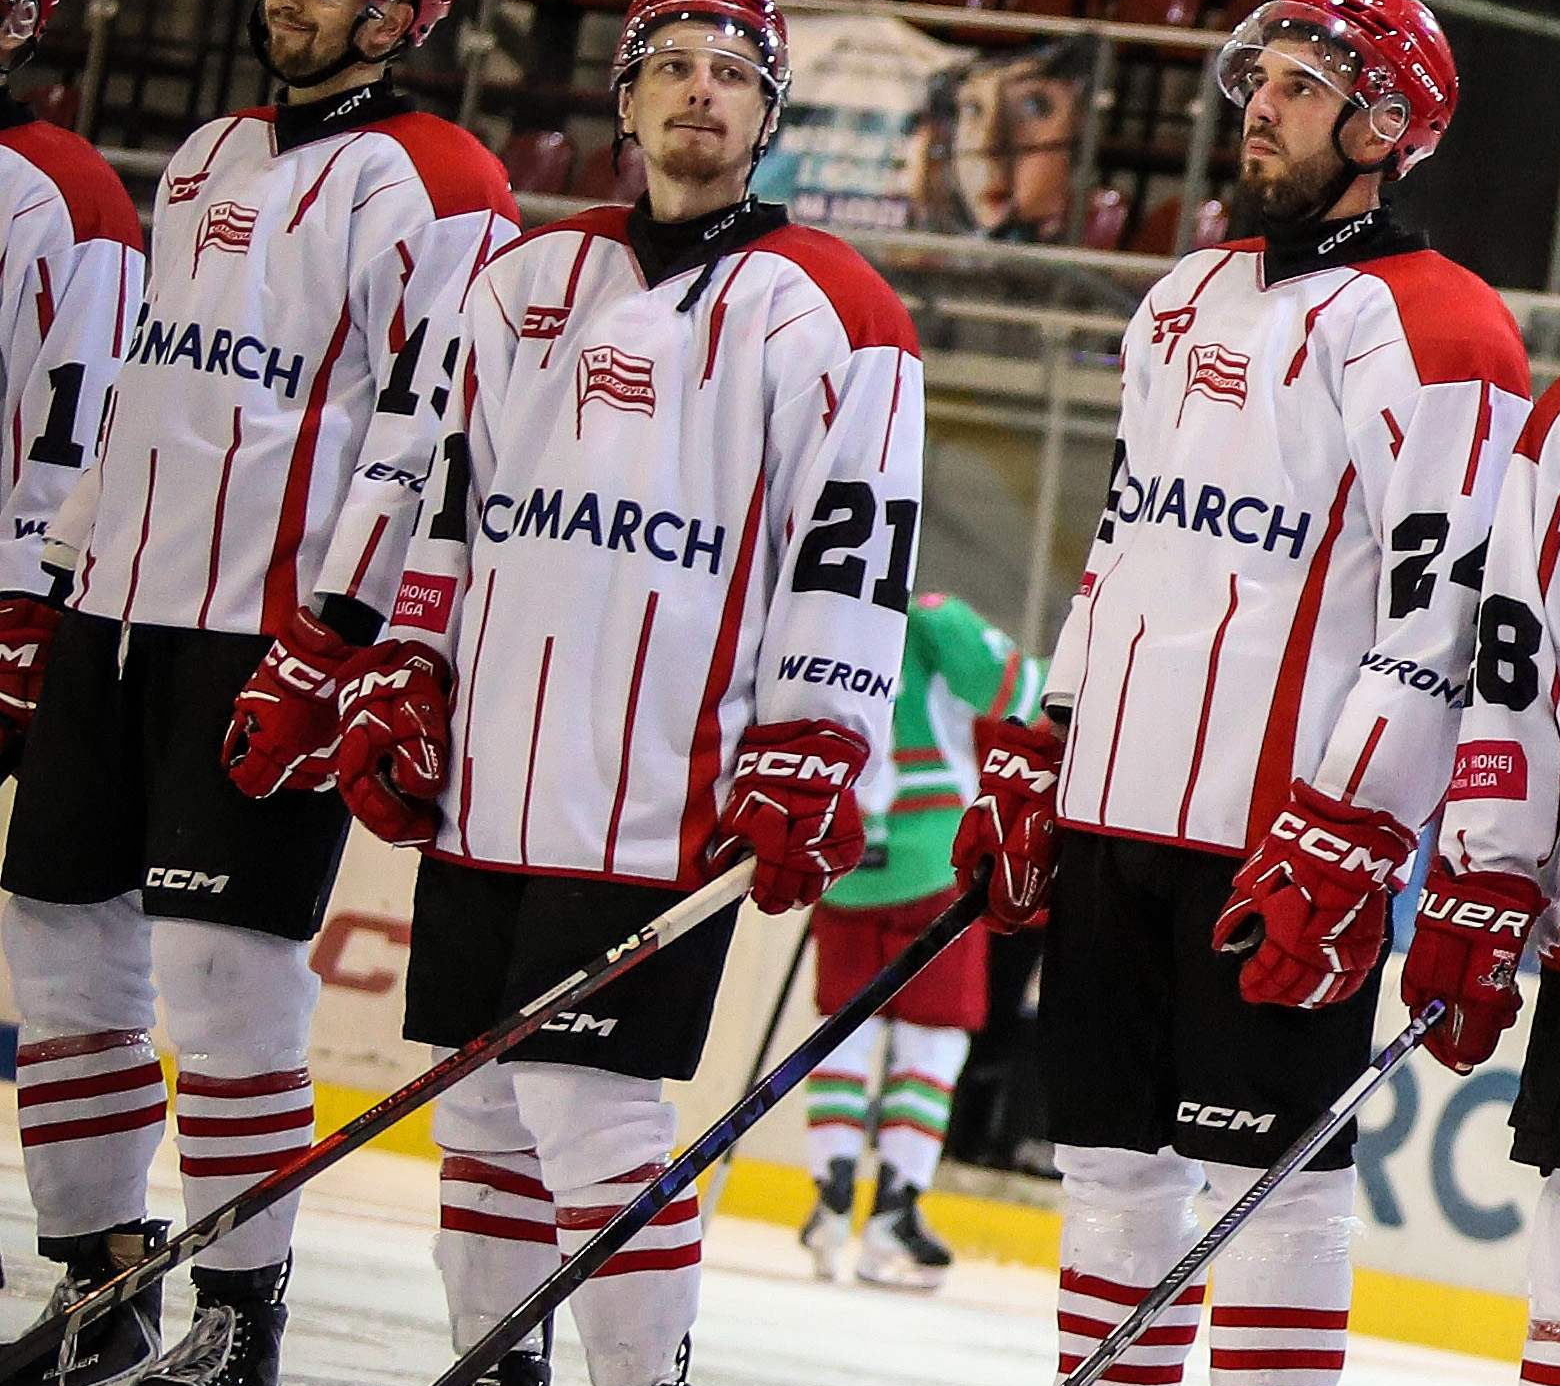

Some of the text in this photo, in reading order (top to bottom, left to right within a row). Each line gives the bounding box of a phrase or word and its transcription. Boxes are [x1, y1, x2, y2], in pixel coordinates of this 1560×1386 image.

[1411, 62, 1444, 103] CCM
[1317, 212, 1375, 256] CCM
[522, 316, 569, 333] CM
[130, 302, 305, 400] MARCH
[28, 361, 115, 470] 1
[1119, 476, 1311, 560] OARCH
[792, 480, 926, 612] 21
[777, 656, 895, 698] WERON
[735, 751, 849, 786] CCM
[982, 748, 1057, 795] CM
[1470, 754, 1513, 773] HOKEJ
[1270, 810, 1396, 885] CCM
[146, 867, 230, 895] CCM
[1417, 886, 1531, 938] UER
[1177, 1101, 1277, 1135] CCM
